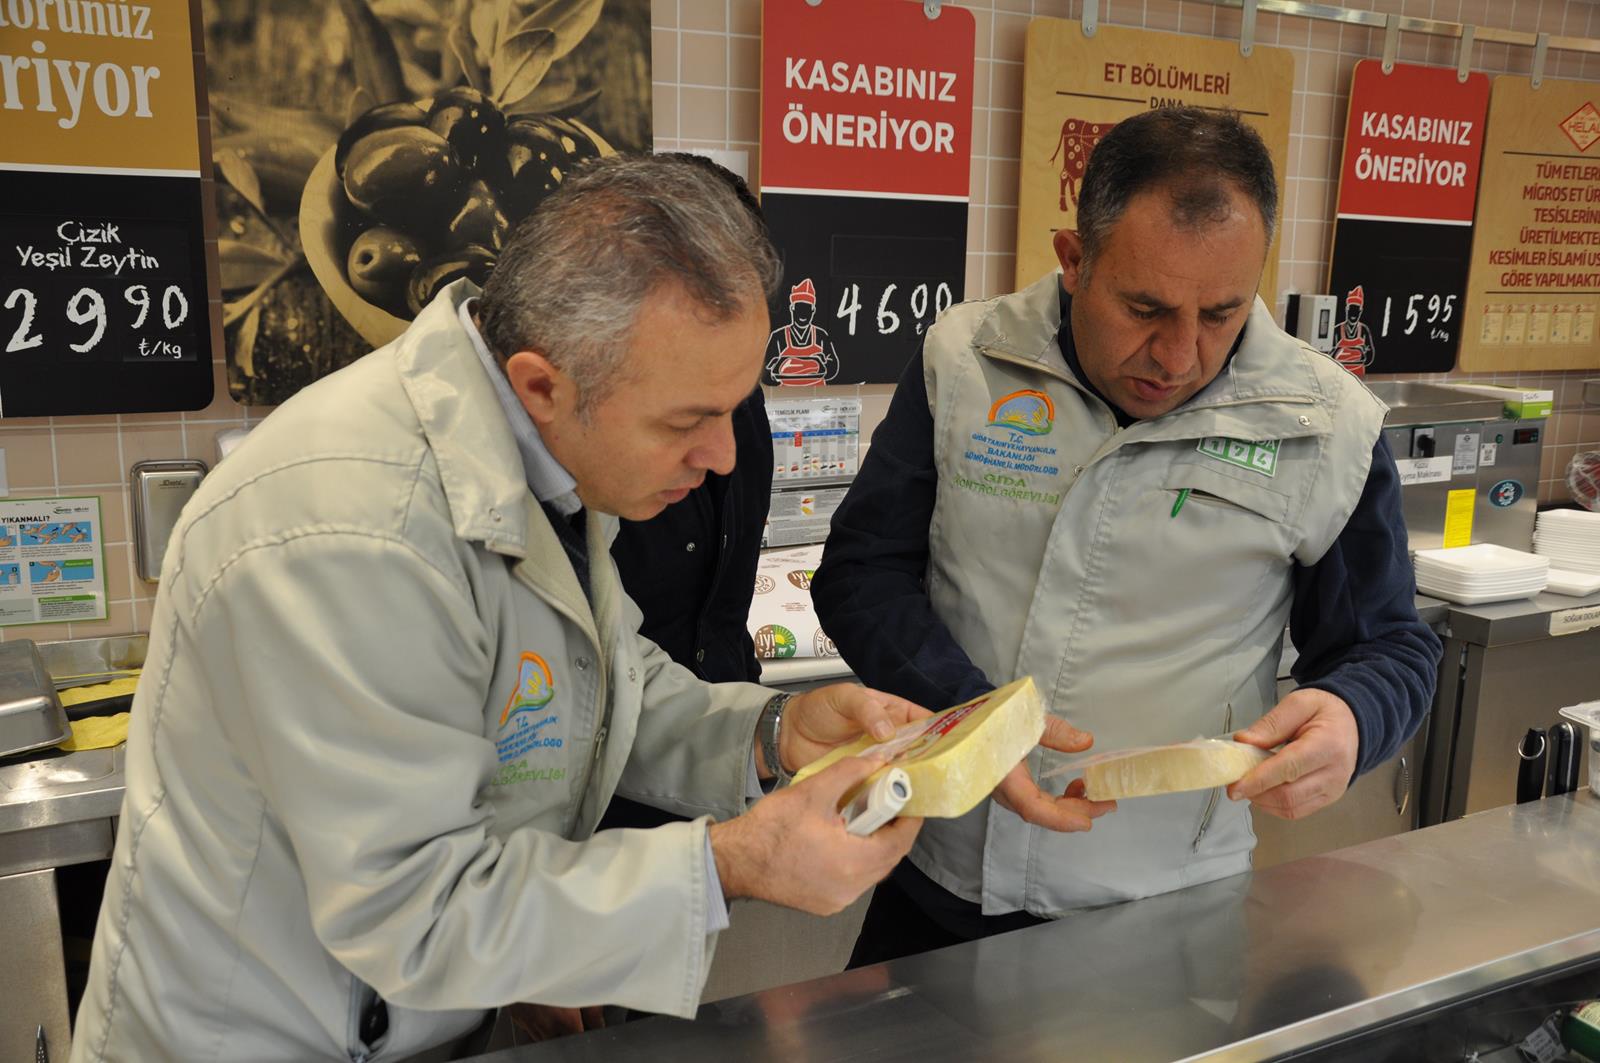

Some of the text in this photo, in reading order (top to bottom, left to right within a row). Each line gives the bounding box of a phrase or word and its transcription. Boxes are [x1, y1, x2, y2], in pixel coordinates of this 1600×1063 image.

[785, 57, 957, 102] KASABINIZ
[1103, 62, 1230, 95] ET BÖLÜMLERİ
[782, 102, 955, 154] ÖNERİYOR
[1360, 111, 1473, 146] KASABINIZ
[1354, 148, 1467, 187] ÖNERİYOR
[1536, 161, 1562, 179] TÜM
[1523, 182, 1568, 202] MİGROS
[1569, 187, 1584, 202] ET
[57, 221, 121, 246] Çizik
[16, 245, 159, 275] Yeşil Zeytin
[1489, 248, 1546, 266] KESİMLER
[1501, 270, 1532, 287] GÖRE
